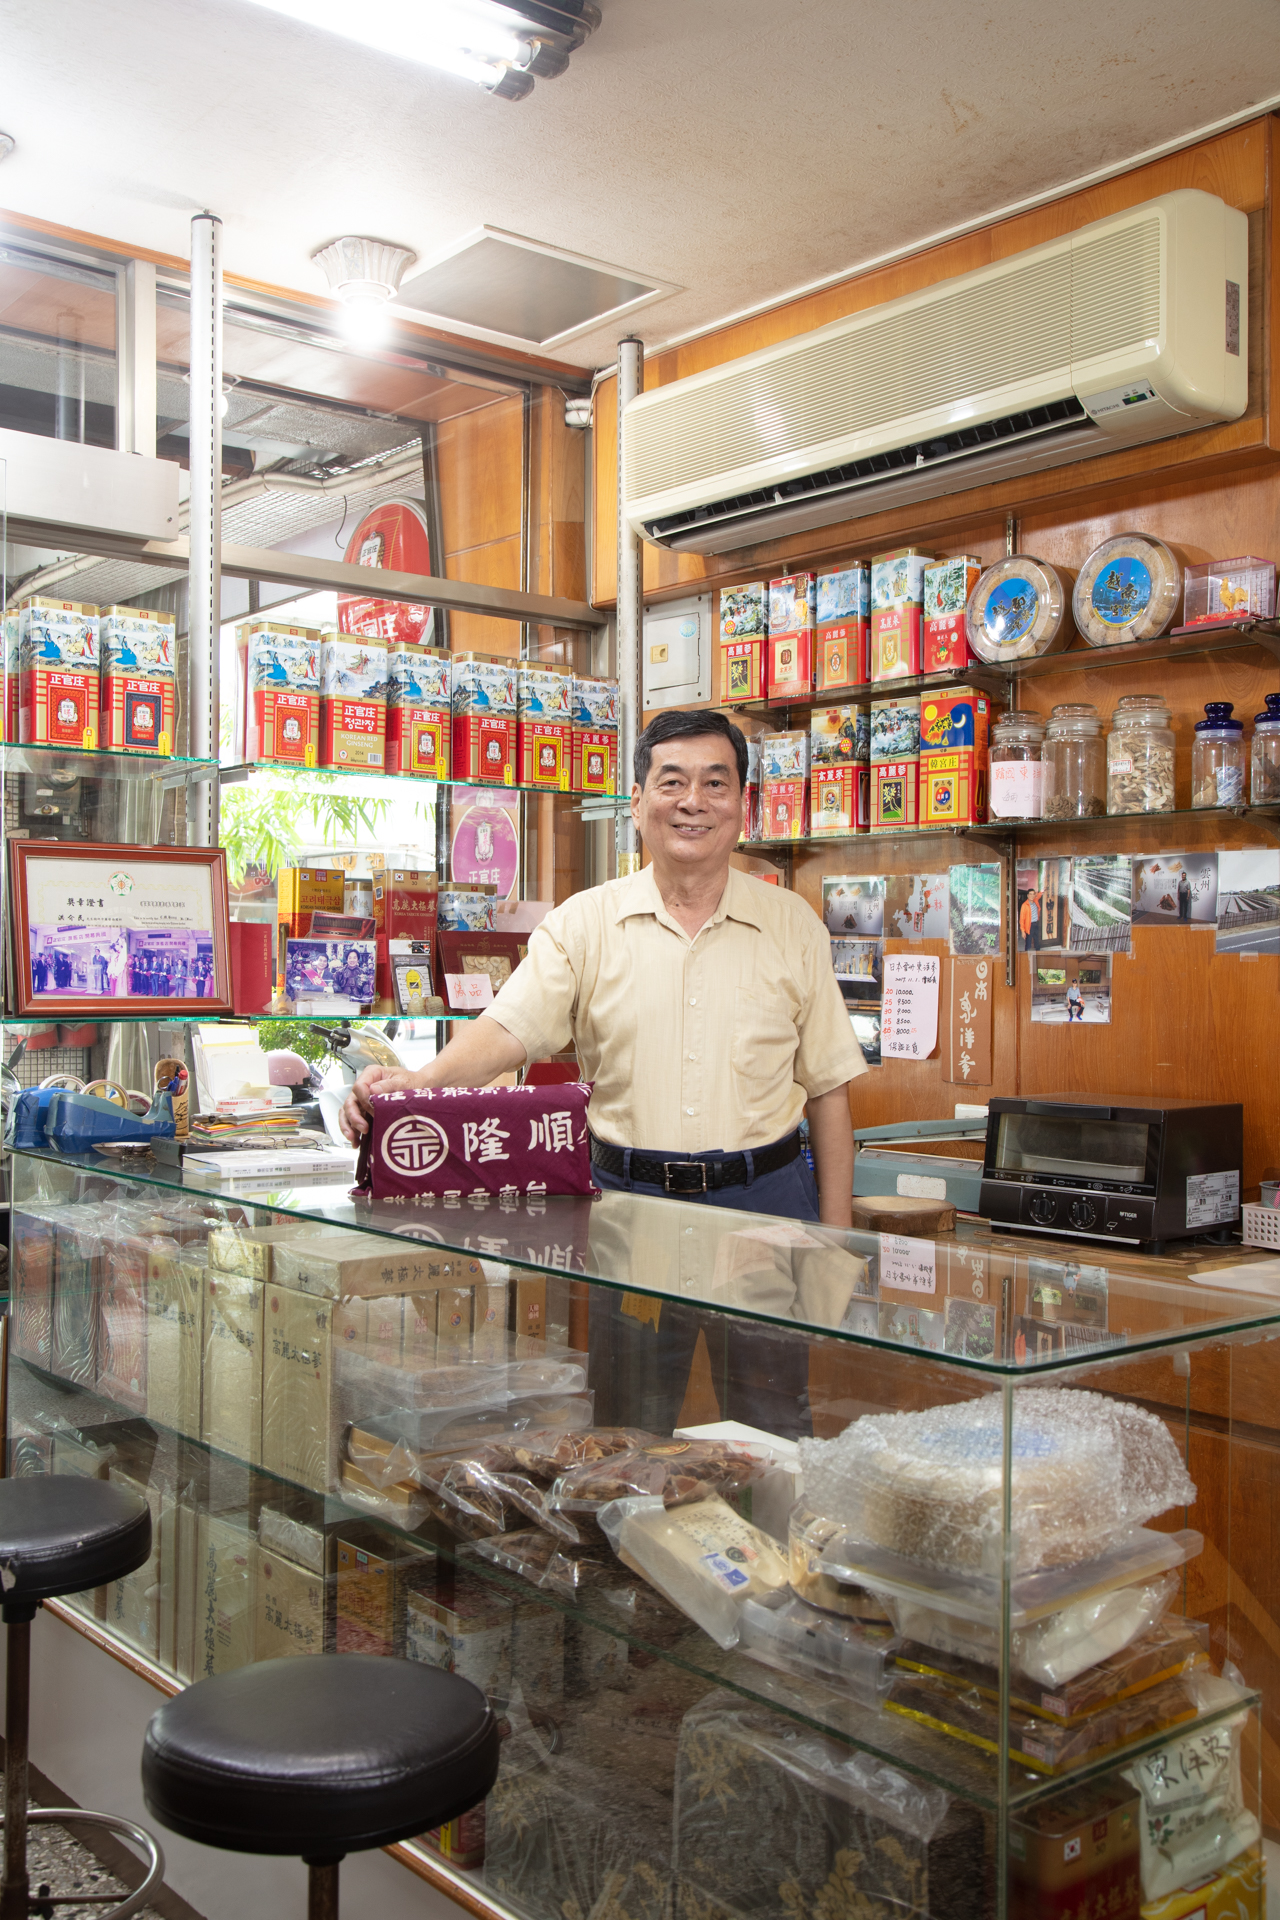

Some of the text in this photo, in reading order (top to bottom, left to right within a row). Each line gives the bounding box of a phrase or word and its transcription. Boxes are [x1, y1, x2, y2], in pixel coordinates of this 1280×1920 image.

[1097, 403, 1120, 413] HITACHI
[1103, 571, 1140, 601] 越南
[50, 674, 85, 687] 正官庄
[127, 680, 160, 693] 正官庄
[277, 694, 308, 707] 正官庄
[344, 705, 376, 719] 正官庄
[413, 710, 440, 723] 正官庄
[344, 718, 375, 732] 정관장
[481, 718, 507, 730] 正官庄
[535, 725, 562, 736] 正官庄
[341, 733, 365, 742] KOREAN
[346, 740, 374, 748] GINSENG
[975, 961, 988, 1001] 日本
[1124, 1211, 1137, 1219] TIGER
